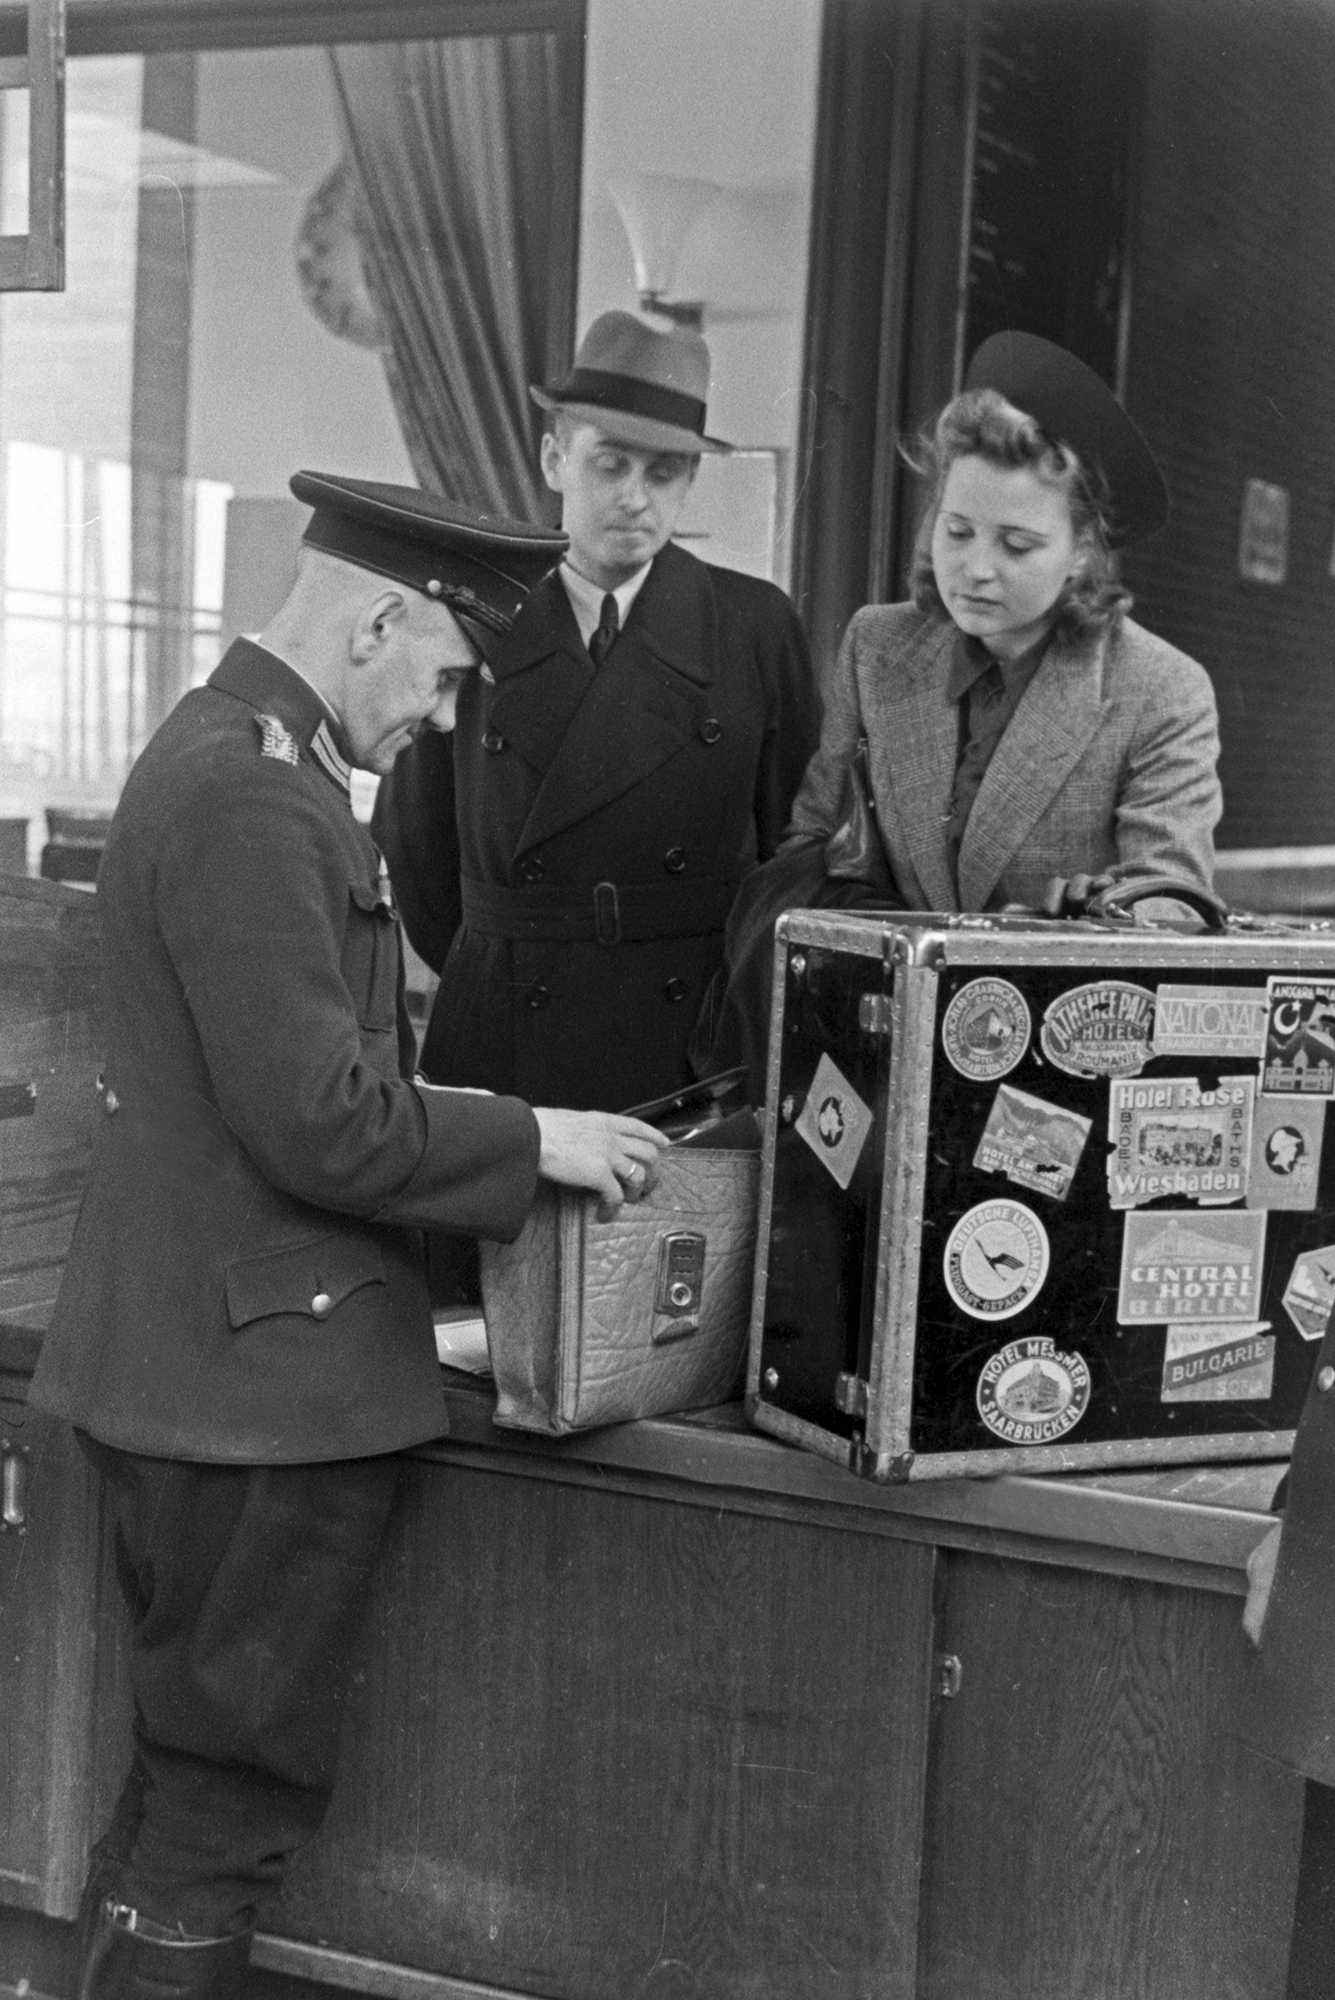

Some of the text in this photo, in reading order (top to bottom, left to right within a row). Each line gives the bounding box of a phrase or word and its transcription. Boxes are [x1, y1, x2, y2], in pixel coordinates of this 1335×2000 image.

[1118, 992, 1155, 1032] PALA
[1157, 1002, 1262, 1034] NATIONAL
[1082, 1023, 1134, 1040] HOTEL
[1076, 1051, 1137, 1067] ROUMANIE
[1120, 1086, 1173, 1109] Hotel
[1229, 1108, 1243, 1167] BATHS
[982, 1146, 1015, 1165] HOTEL
[1115, 1171, 1240, 1195] Wiesbaden
[953, 1207, 1042, 1288] DEUTSCHE LUFTHANSA
[1131, 1265, 1253, 1283] CENTRAL
[1159, 1281, 1254, 1298] HOTEL
[1129, 1299, 1249, 1315] BERLIN
[984, 1341, 1087, 1388] HOTEL MESSMER
[1172, 1340, 1267, 1382] BULGARIE
[982, 1401, 1080, 1440] SAARBRÜCKEN
